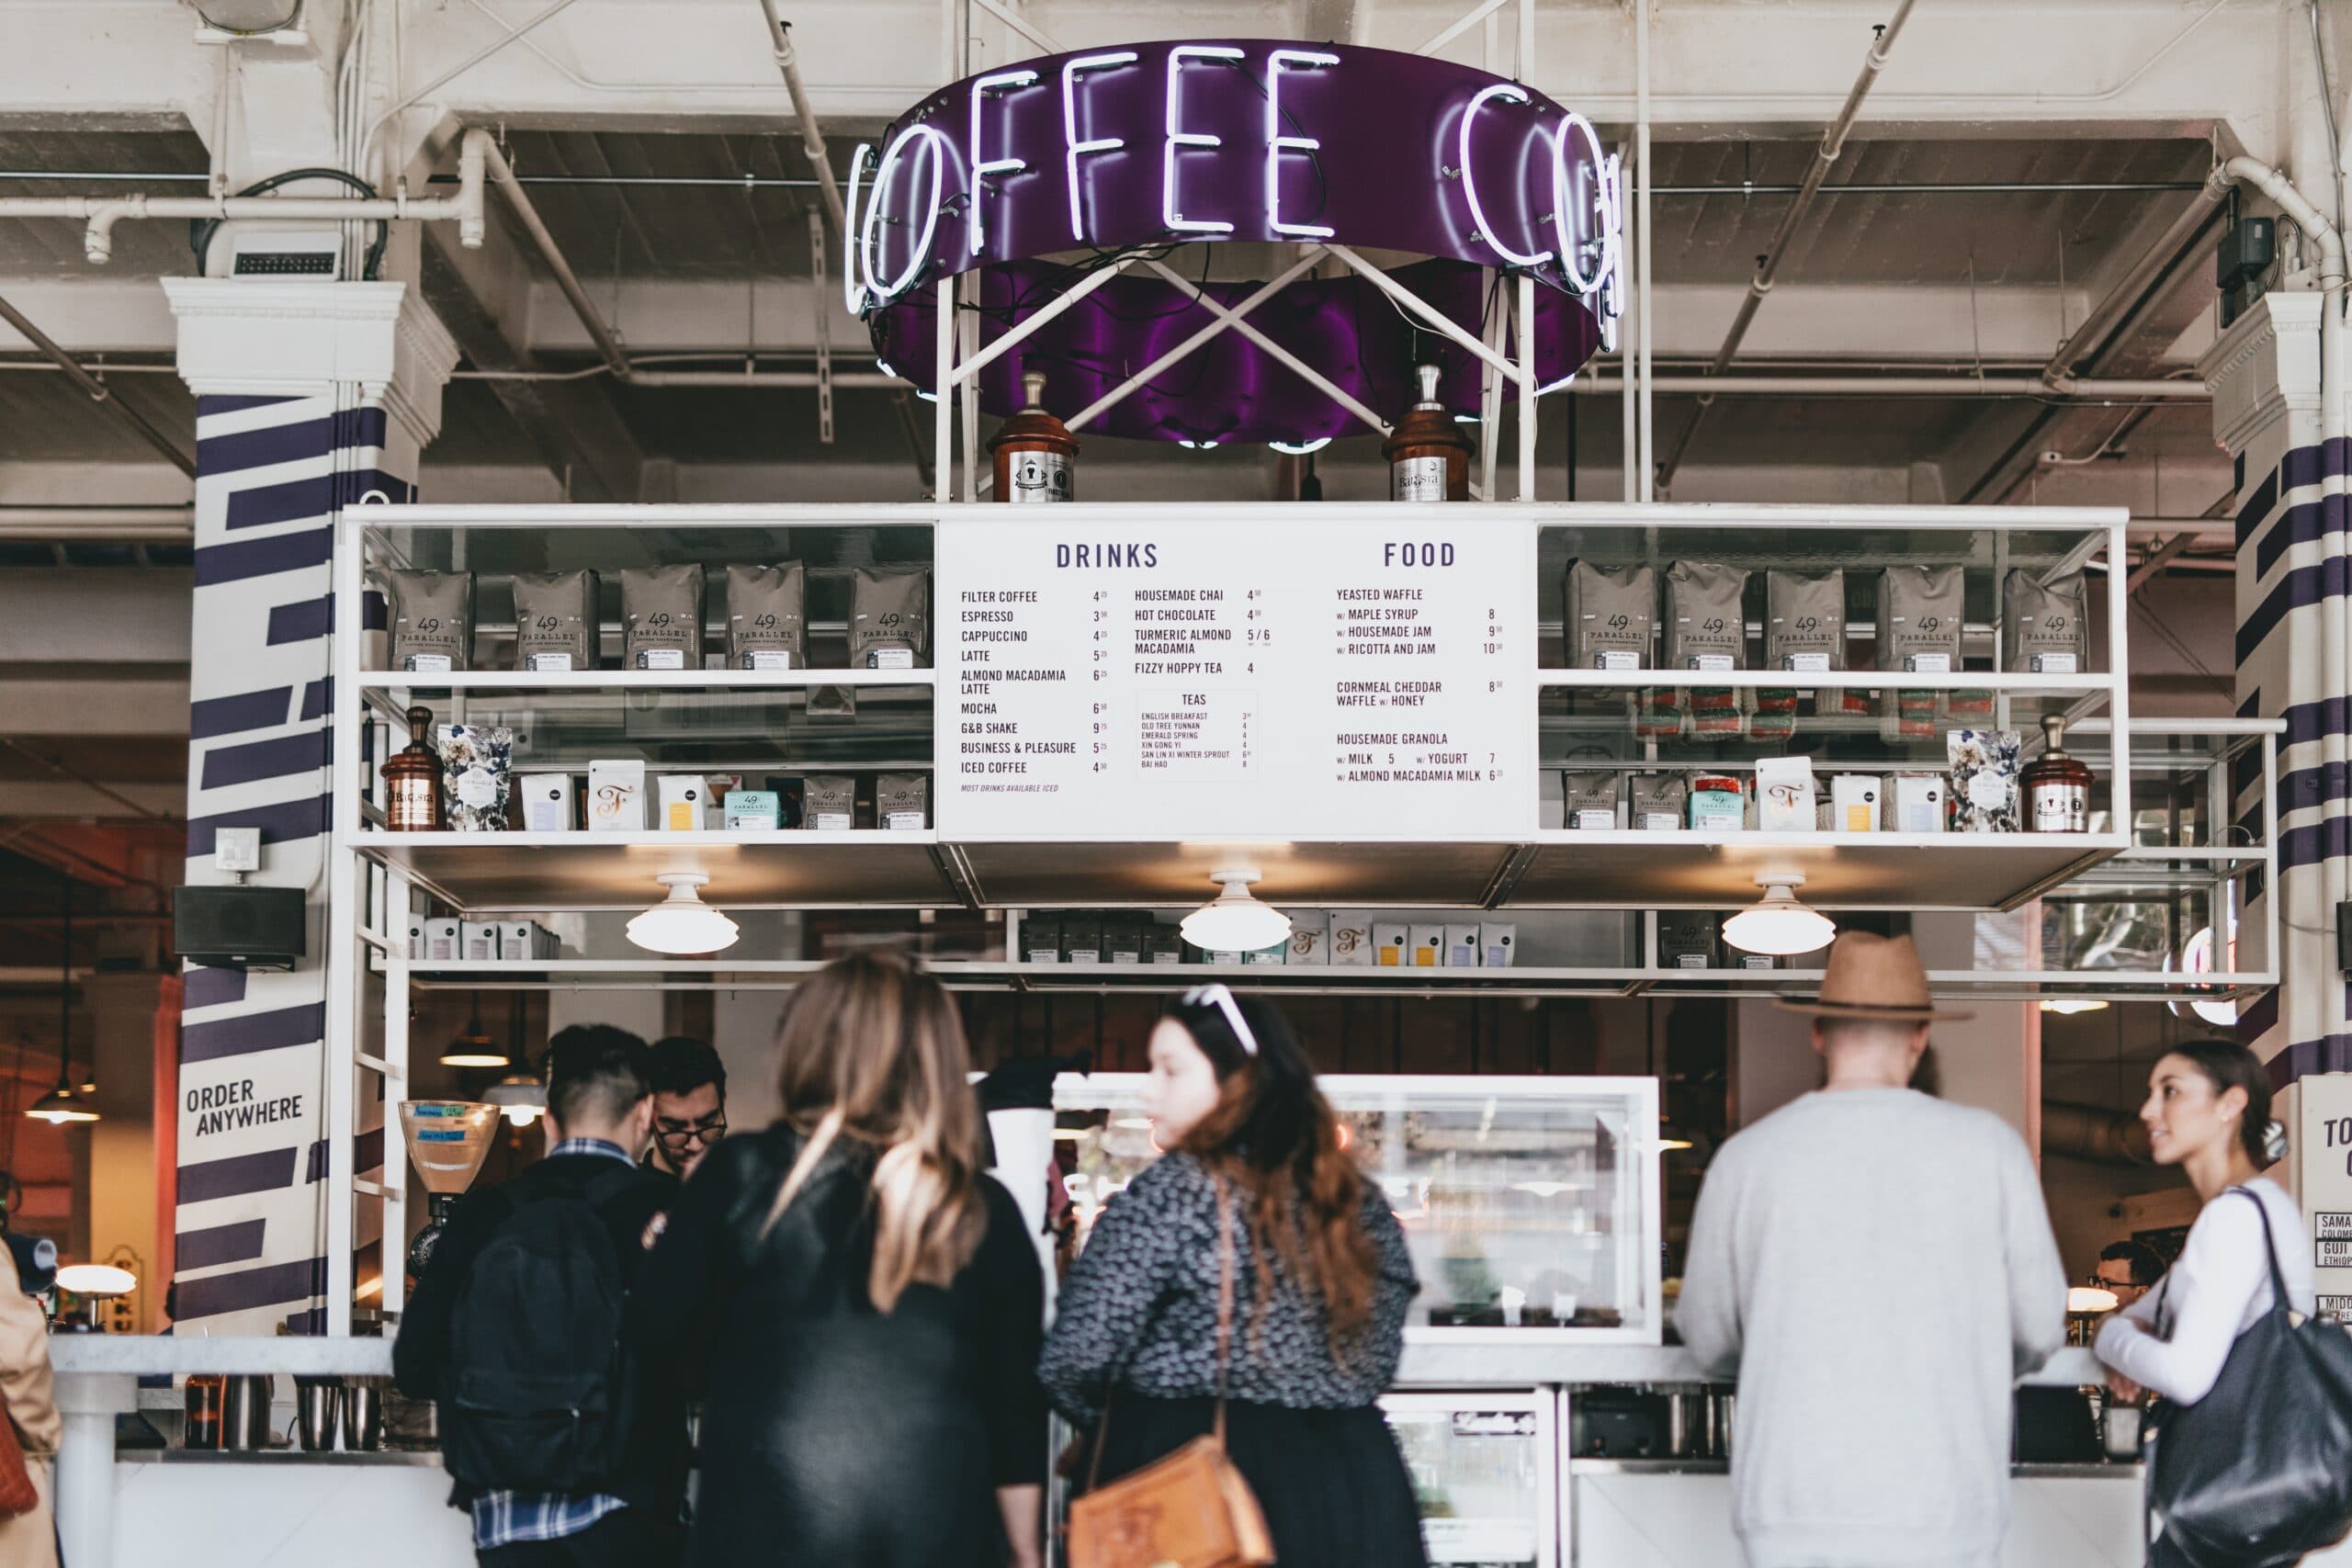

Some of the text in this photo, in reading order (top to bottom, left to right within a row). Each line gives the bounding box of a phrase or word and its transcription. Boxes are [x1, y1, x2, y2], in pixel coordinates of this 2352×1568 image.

[844, 46, 1341, 315] COFFEE
[1057, 544, 1157, 568] DRINKS
[1385, 542, 1454, 567] FOOD
[962, 592, 995, 603] FILTER
[1000, 591, 1037, 603] COFFEE
[1135, 590, 1196, 602] HOUSEMADE
[1200, 589, 1223, 602] CHAI
[1337, 589, 1423, 601] YEASTED WAFFLE
[962, 610, 1013, 624] ESPRESSO
[1136, 610, 1154, 621] HOT
[1158, 610, 1216, 621] CHOCOLATE
[1349, 609, 1382, 620] MAPLE
[1384, 609, 1419, 620] SYRUP
[1488, 609, 1495, 620] 8
[523, 632, 576, 640] PARALLEL
[633, 629, 687, 637] PARALLEL
[740, 631, 793, 639] PARALLEL
[863, 629, 916, 638] PARALLEL
[962, 630, 1027, 642] CAPPUCCINO
[1135, 629, 1187, 641] TURMERIC
[1190, 629, 1231, 641] ALMOND
[1349, 625, 1409, 637] HOUSEMADE
[1413, 626, 1431, 637] JAM
[1590, 632, 1644, 640] PARALLEL
[401, 635, 456, 643] PARALLEL
[1685, 635, 1738, 643] PARALLEL
[1779, 634, 1833, 642] PARALLEL
[1135, 643, 1195, 654] MACADAMIA
[1349, 643, 1390, 654] RICOTTA
[1394, 643, 1413, 654] AND
[1417, 643, 1435, 654] JAM
[962, 650, 990, 661] LATTE
[1135, 661, 1253, 674] FIZZY HOPPY TEA 4
[961, 669, 1002, 682] ALMOND
[1006, 670, 1066, 682] MACADAMIA
[961, 683, 990, 694] LATTE
[1338, 682, 1391, 693] CORNMEAL
[1395, 682, 1442, 693] CHEDDAR
[1182, 694, 1205, 705] TEAS
[1337, 695, 1376, 706] WAFFLE
[1392, 695, 1425, 705] HONEY
[961, 703, 997, 714] MOCHA
[1170, 713, 1207, 721] BREAKFAST
[961, 723, 982, 735] G&B
[986, 723, 1018, 734] SHAKE
[1142, 722, 1154, 730] OLD
[1156, 721, 1172, 730] TREE
[1173, 721, 1200, 730] YUNNAN
[1141, 731, 1171, 739] EMERALD
[1173, 731, 1198, 739] SPRING
[1338, 733, 1448, 745] HOUSEMADE GRANOLA
[961, 742, 1011, 753] BUSINESS
[1014, 742, 1022, 753] &
[1025, 742, 1076, 753] PLEASURE
[1177, 750, 1202, 759] WINTER
[1349, 753, 1373, 764] MILK
[1389, 753, 1395, 764] 5
[1428, 753, 1468, 764] YOGURT
[1489, 752, 1495, 763] 7
[961, 761, 984, 773] ICED
[989, 761, 1027, 773] COFFEE
[1349, 771, 1389, 782] ALMOND
[1394, 770, 1453, 783] MACADAMIA
[1456, 770, 1481, 782] MILK
[961, 784, 1058, 794] MOST DRINKS AVAILABLE ICED
[187, 1079, 254, 1112] ORDER
[196, 1095, 302, 1136] ANYWHERE
[2322, 1215, 2352, 1227] SAMA
[2324, 1243, 2347, 1255] GUJI
